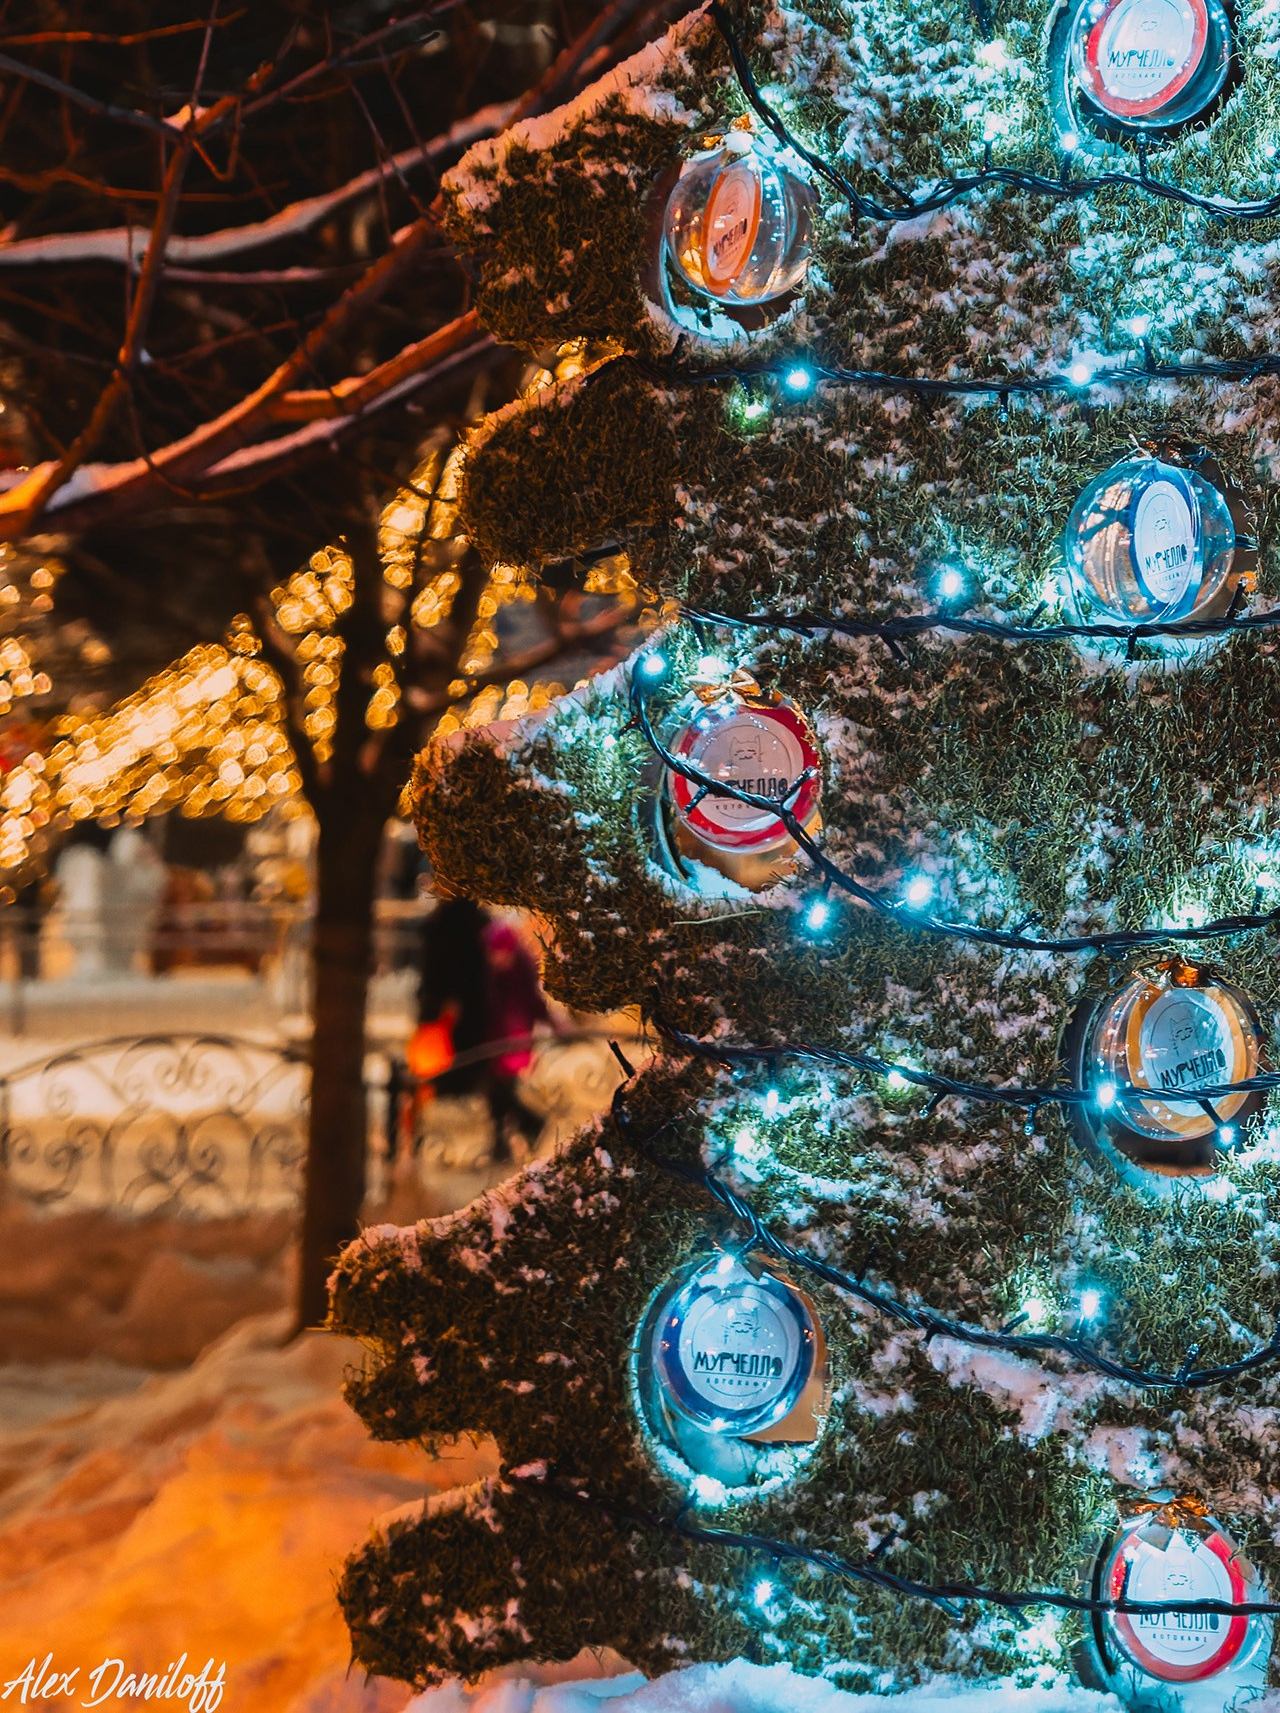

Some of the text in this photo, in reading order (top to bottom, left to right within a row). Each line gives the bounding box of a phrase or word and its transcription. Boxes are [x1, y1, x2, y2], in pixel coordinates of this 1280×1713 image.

[712, 777, 789, 802] ЧЕЛЛО
[715, 802, 751, 811] КОТОК
[693, 1351, 784, 1377] МУРЧЕЛЛО
